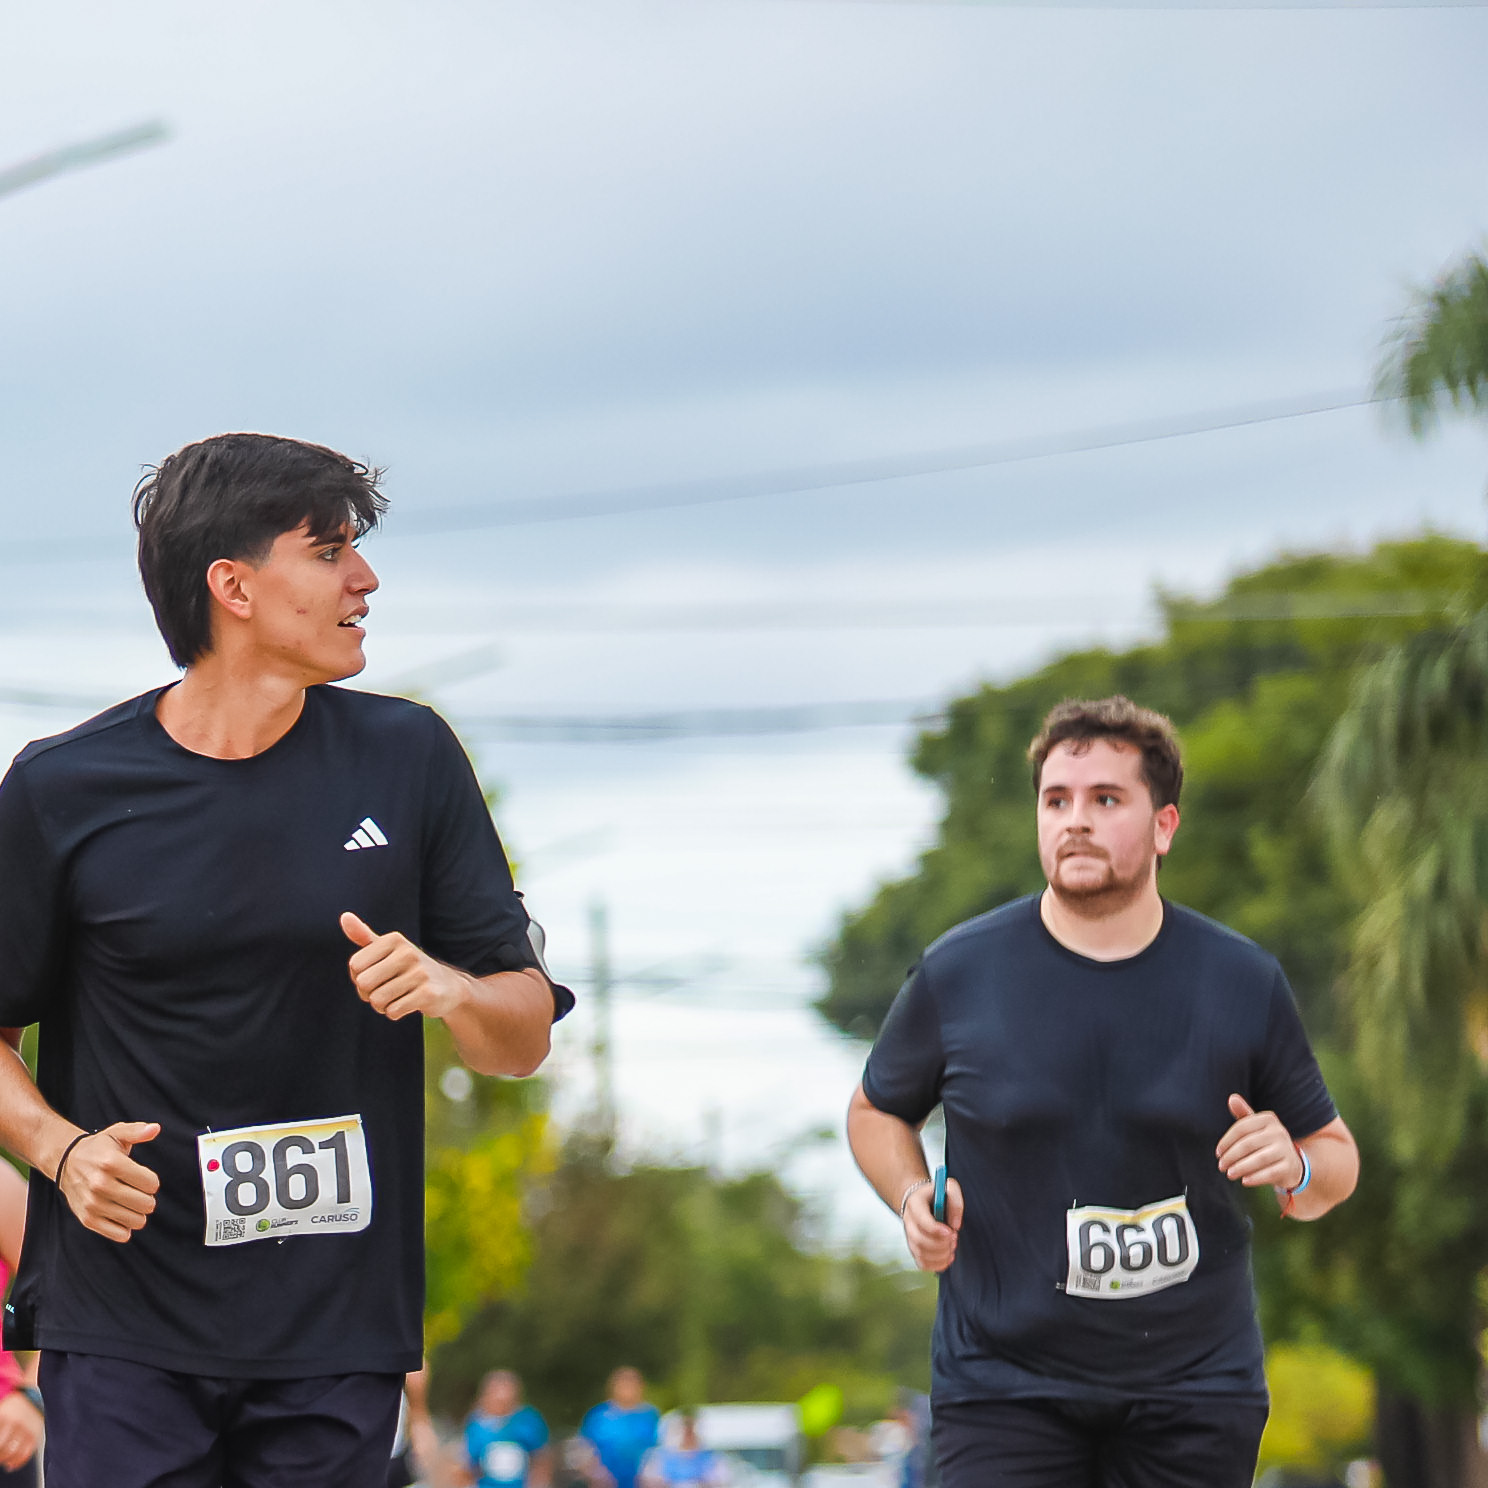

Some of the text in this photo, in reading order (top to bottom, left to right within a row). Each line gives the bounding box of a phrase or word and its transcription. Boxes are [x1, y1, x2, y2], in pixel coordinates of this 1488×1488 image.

[222, 1130, 351, 1216] 861
[311, 1213, 358, 1224] CARUSO
[1079, 1213, 1189, 1274] 660
